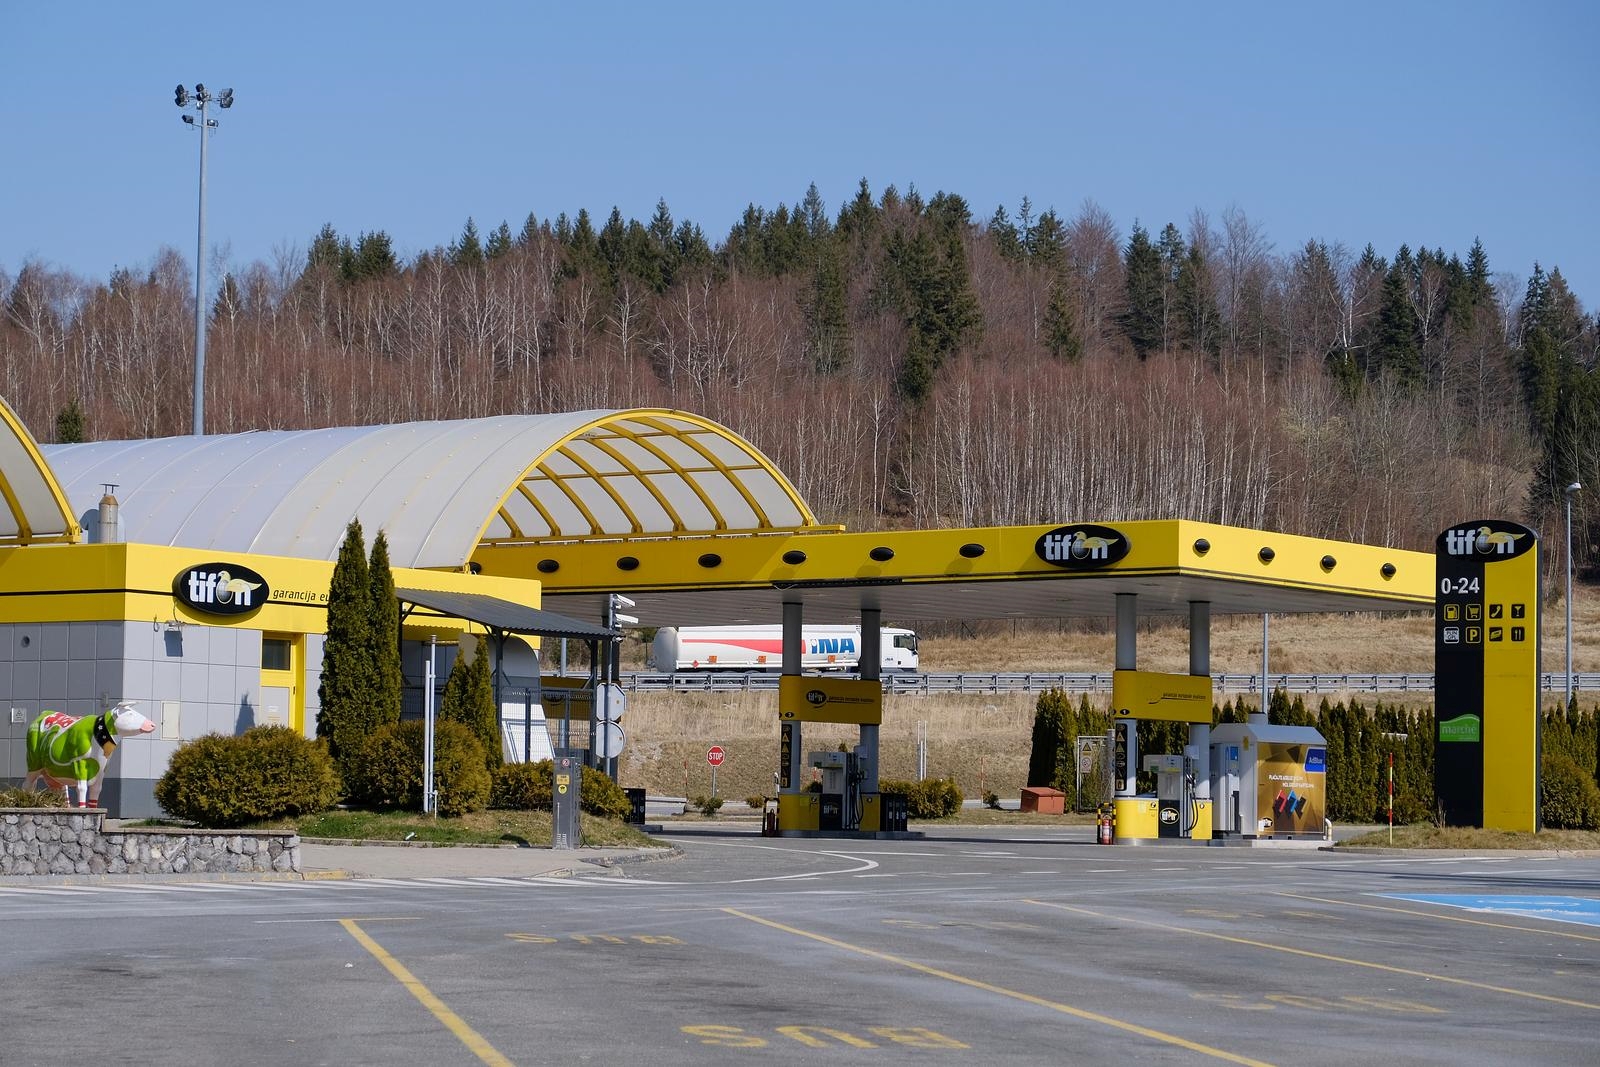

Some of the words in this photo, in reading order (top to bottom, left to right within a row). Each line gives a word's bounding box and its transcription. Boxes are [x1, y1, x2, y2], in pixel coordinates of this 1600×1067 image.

[1044, 533, 1108, 560] tifon
[1446, 529, 1515, 555] tifon
[188, 570, 251, 606] tifon
[273, 588, 316, 602] garancija
[1441, 577, 1480, 595] 0-24
[1469, 629, 1478, 642] P
[810, 638, 856, 655] INA
[709, 752, 723, 760] STOP
[680, 1025, 972, 1049] BUS
